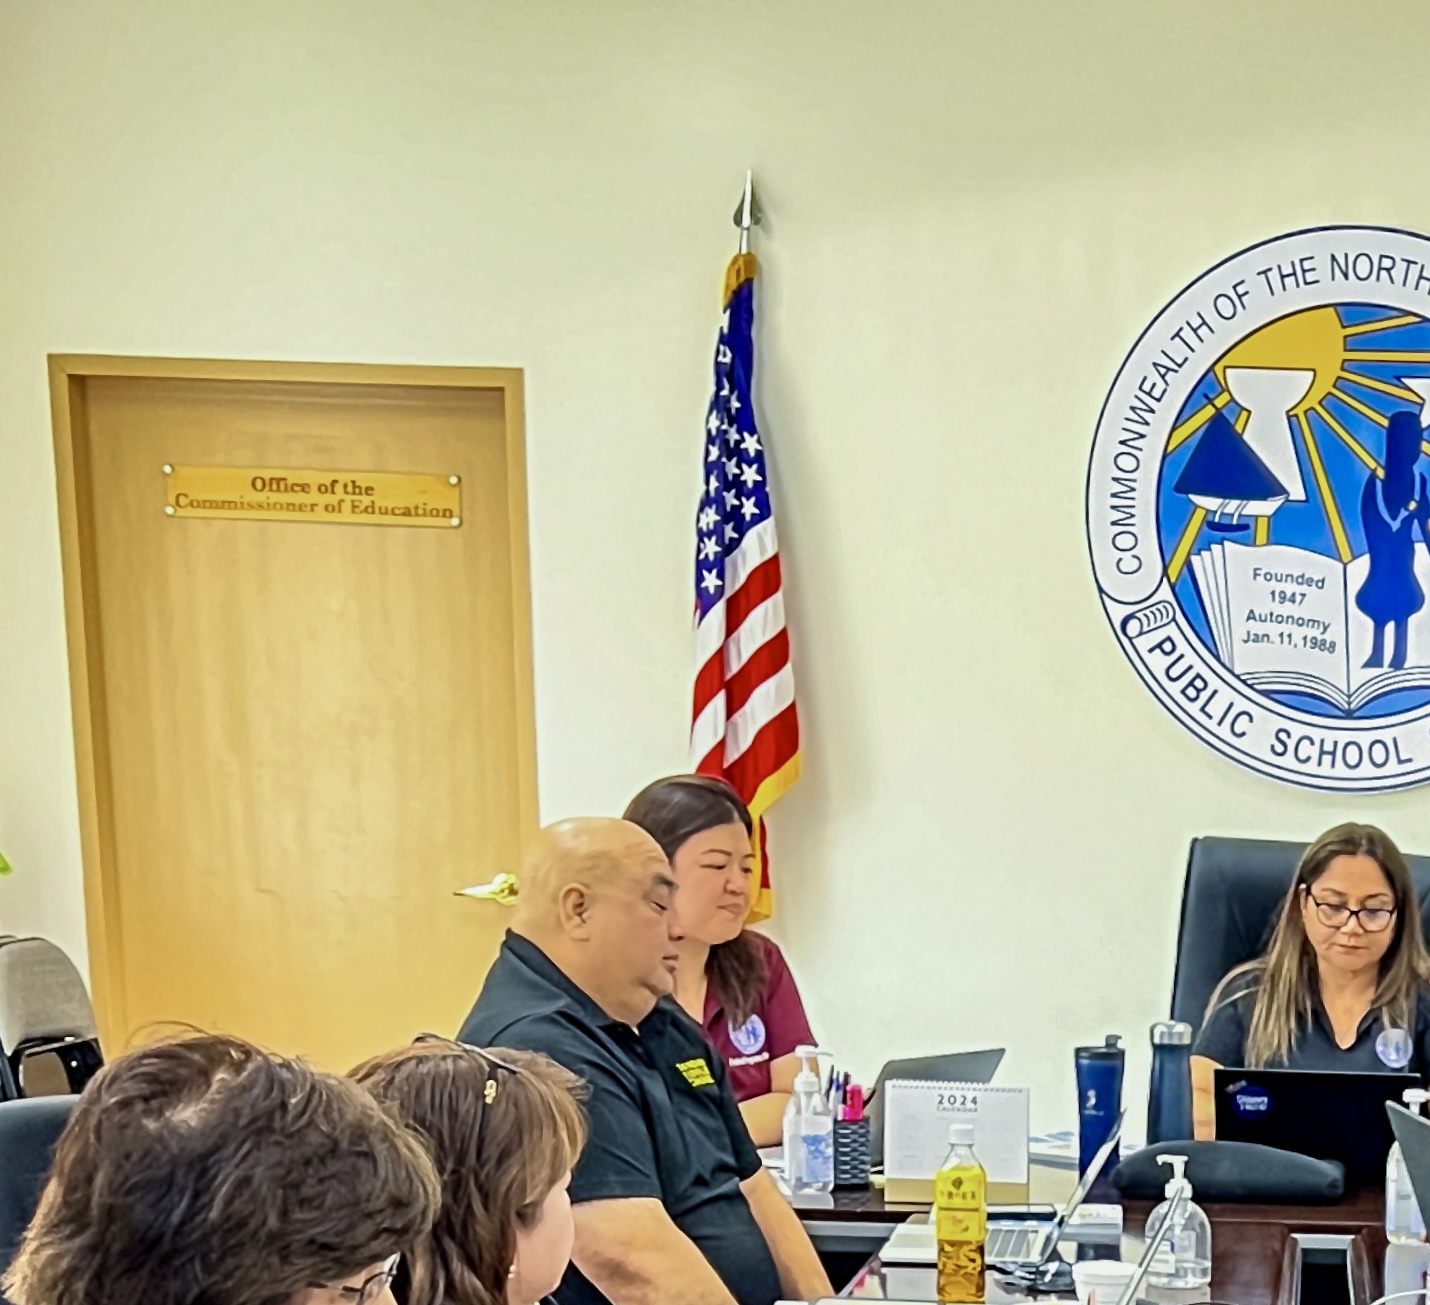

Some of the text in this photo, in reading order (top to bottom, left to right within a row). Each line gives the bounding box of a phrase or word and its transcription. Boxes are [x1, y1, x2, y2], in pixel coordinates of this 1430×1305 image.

[1111, 312, 1218, 576] COMMONWEALTH
[1212, 280, 1252, 321] OF
[1256, 256, 1320, 299] THE
[251, 476, 375, 496] Office of the
[175, 492, 454, 518] Commissioner of Education
[1252, 567, 1326, 590] Founded
[1269, 589, 1307, 607] 1947
[1245, 608, 1331, 635] Autonomy
[1242, 630, 1275, 644] Jan.
[1147, 634, 1254, 740] PUBLIC
[1269, 727, 1413, 770] SCHOOL
[937, 1094, 978, 1106] 2024
